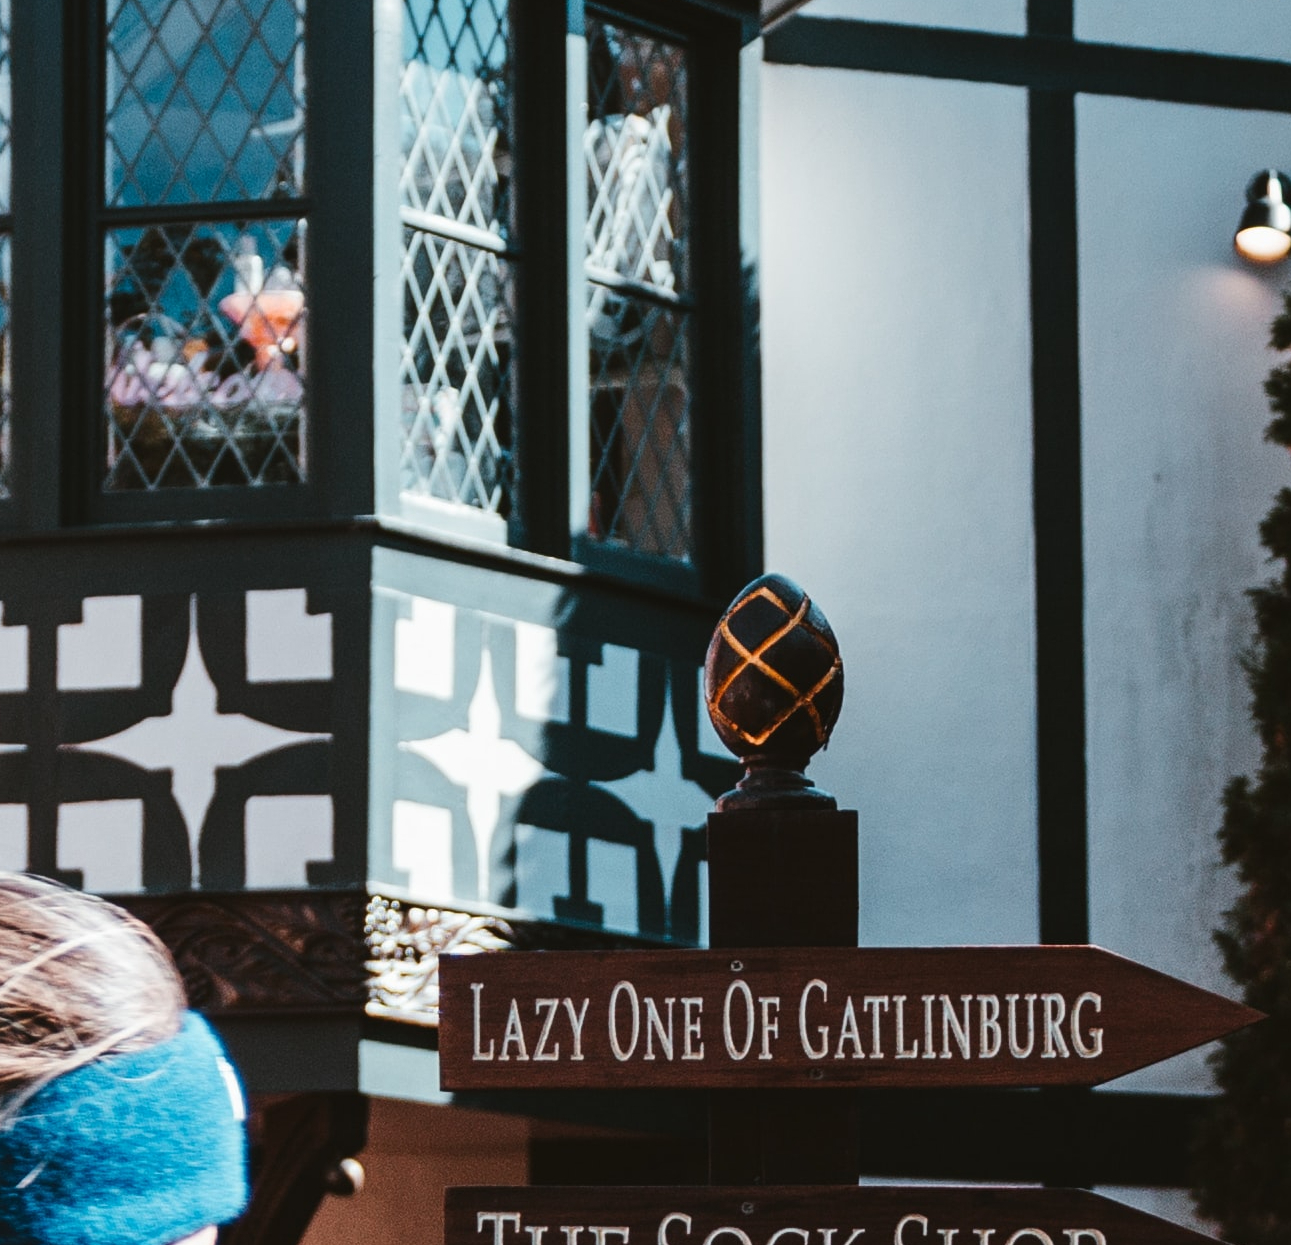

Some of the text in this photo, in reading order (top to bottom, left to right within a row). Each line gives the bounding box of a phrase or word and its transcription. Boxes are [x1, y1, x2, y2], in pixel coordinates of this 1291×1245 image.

[470, 977, 1104, 1062] LAZY ONE OF GATLINBURG
